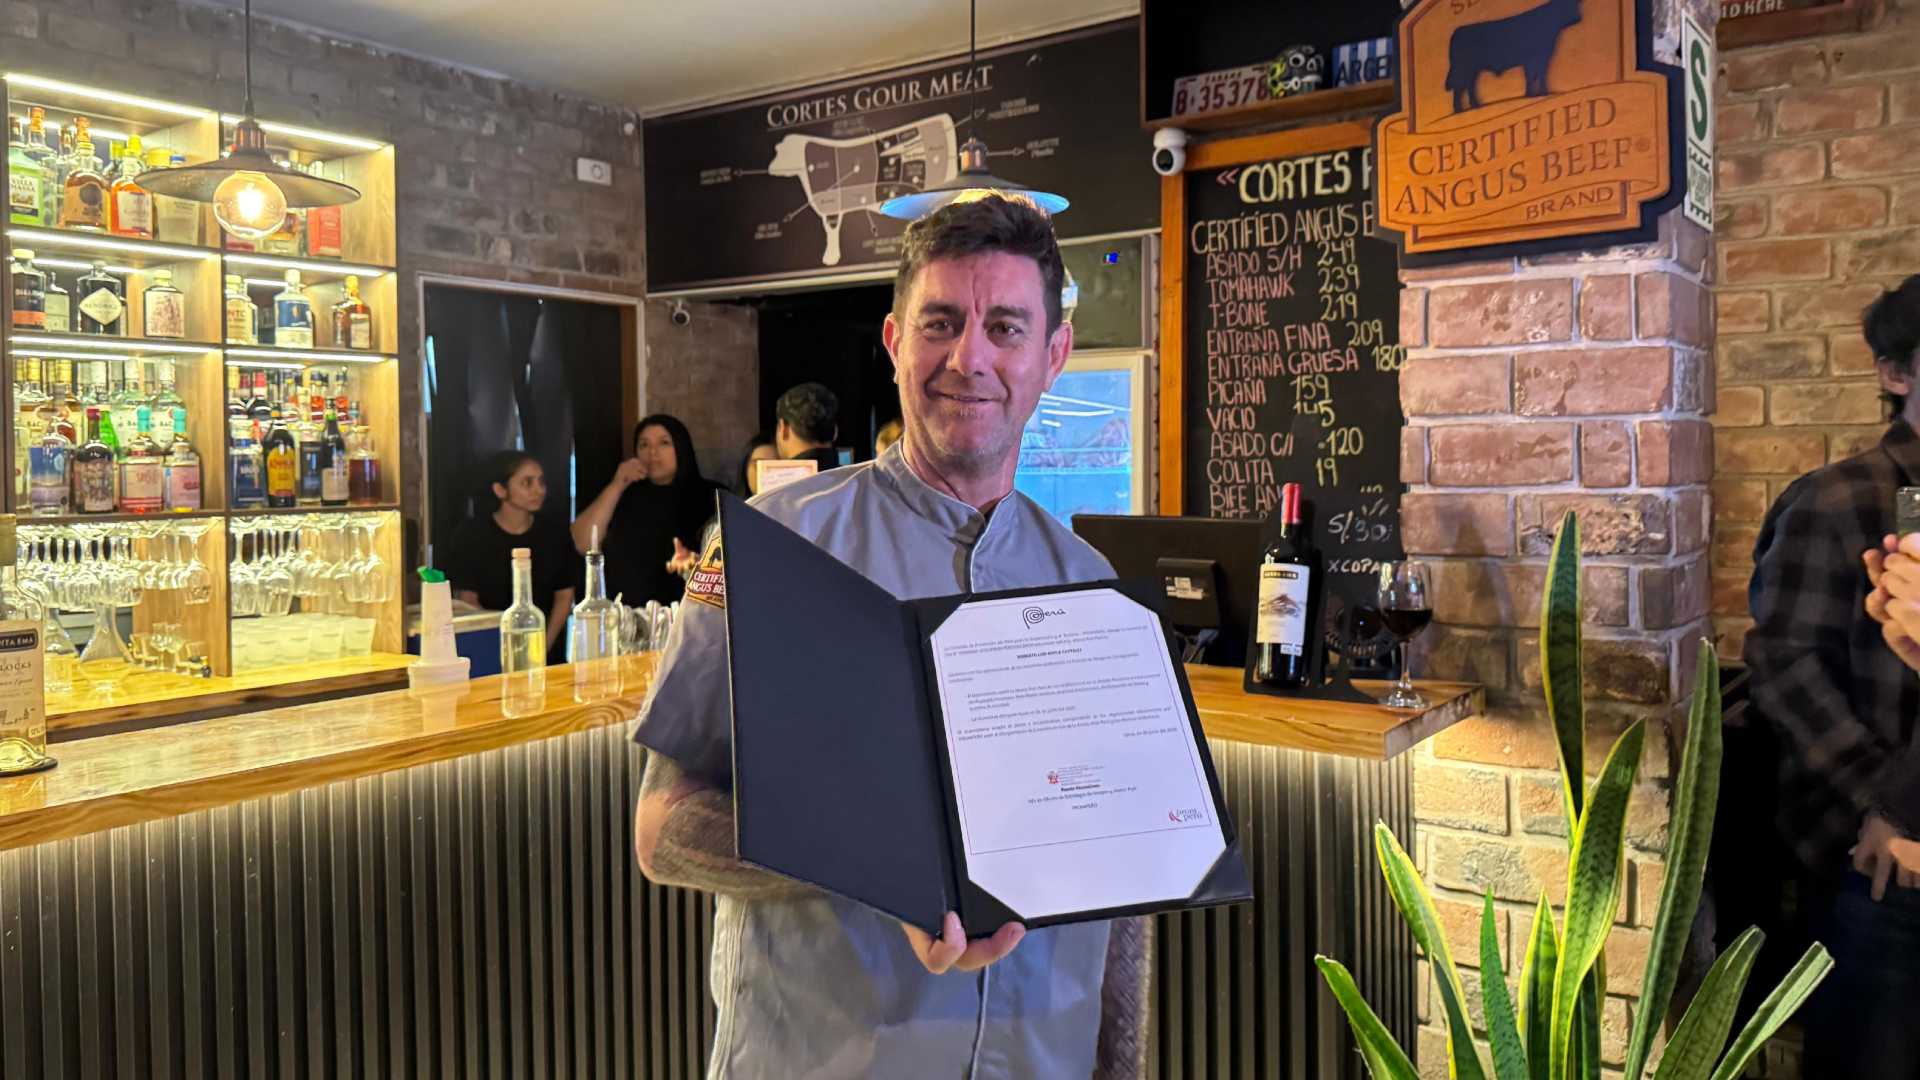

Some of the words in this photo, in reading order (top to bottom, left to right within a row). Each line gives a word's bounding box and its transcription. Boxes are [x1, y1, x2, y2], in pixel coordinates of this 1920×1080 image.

[767, 94, 847, 128] CORTES
[853, 80, 923, 111] GOUR
[929, 65, 994, 97] MEAT
[1408, 97, 1617, 177] CERTIFIED
[1394, 161, 1528, 216] ANGUS
[1526, 186, 1614, 221] BRAND
[1294, 204, 1359, 244] ANGUS
[1206, 252, 1261, 278] ASADO
[1317, 239, 1356, 267] 249
[1207, 272, 1295, 302] TOMAHAWK
[1318, 264, 1360, 294] 239
[1208, 302, 1270, 328] T-BONE
[1320, 293, 1358, 321] 219
[1284, 322, 1332, 350] FINA
[1346, 319, 1384, 347] 209
[1288, 348, 1360, 375] GRUESA
[1372, 345, 1406, 372] 180
[1290, 374, 1330, 401] 159
[1210, 432, 1266, 458] ASADO
[1207, 459, 1275, 485] COLITA
[1209, 485, 1248, 509] BIFE
